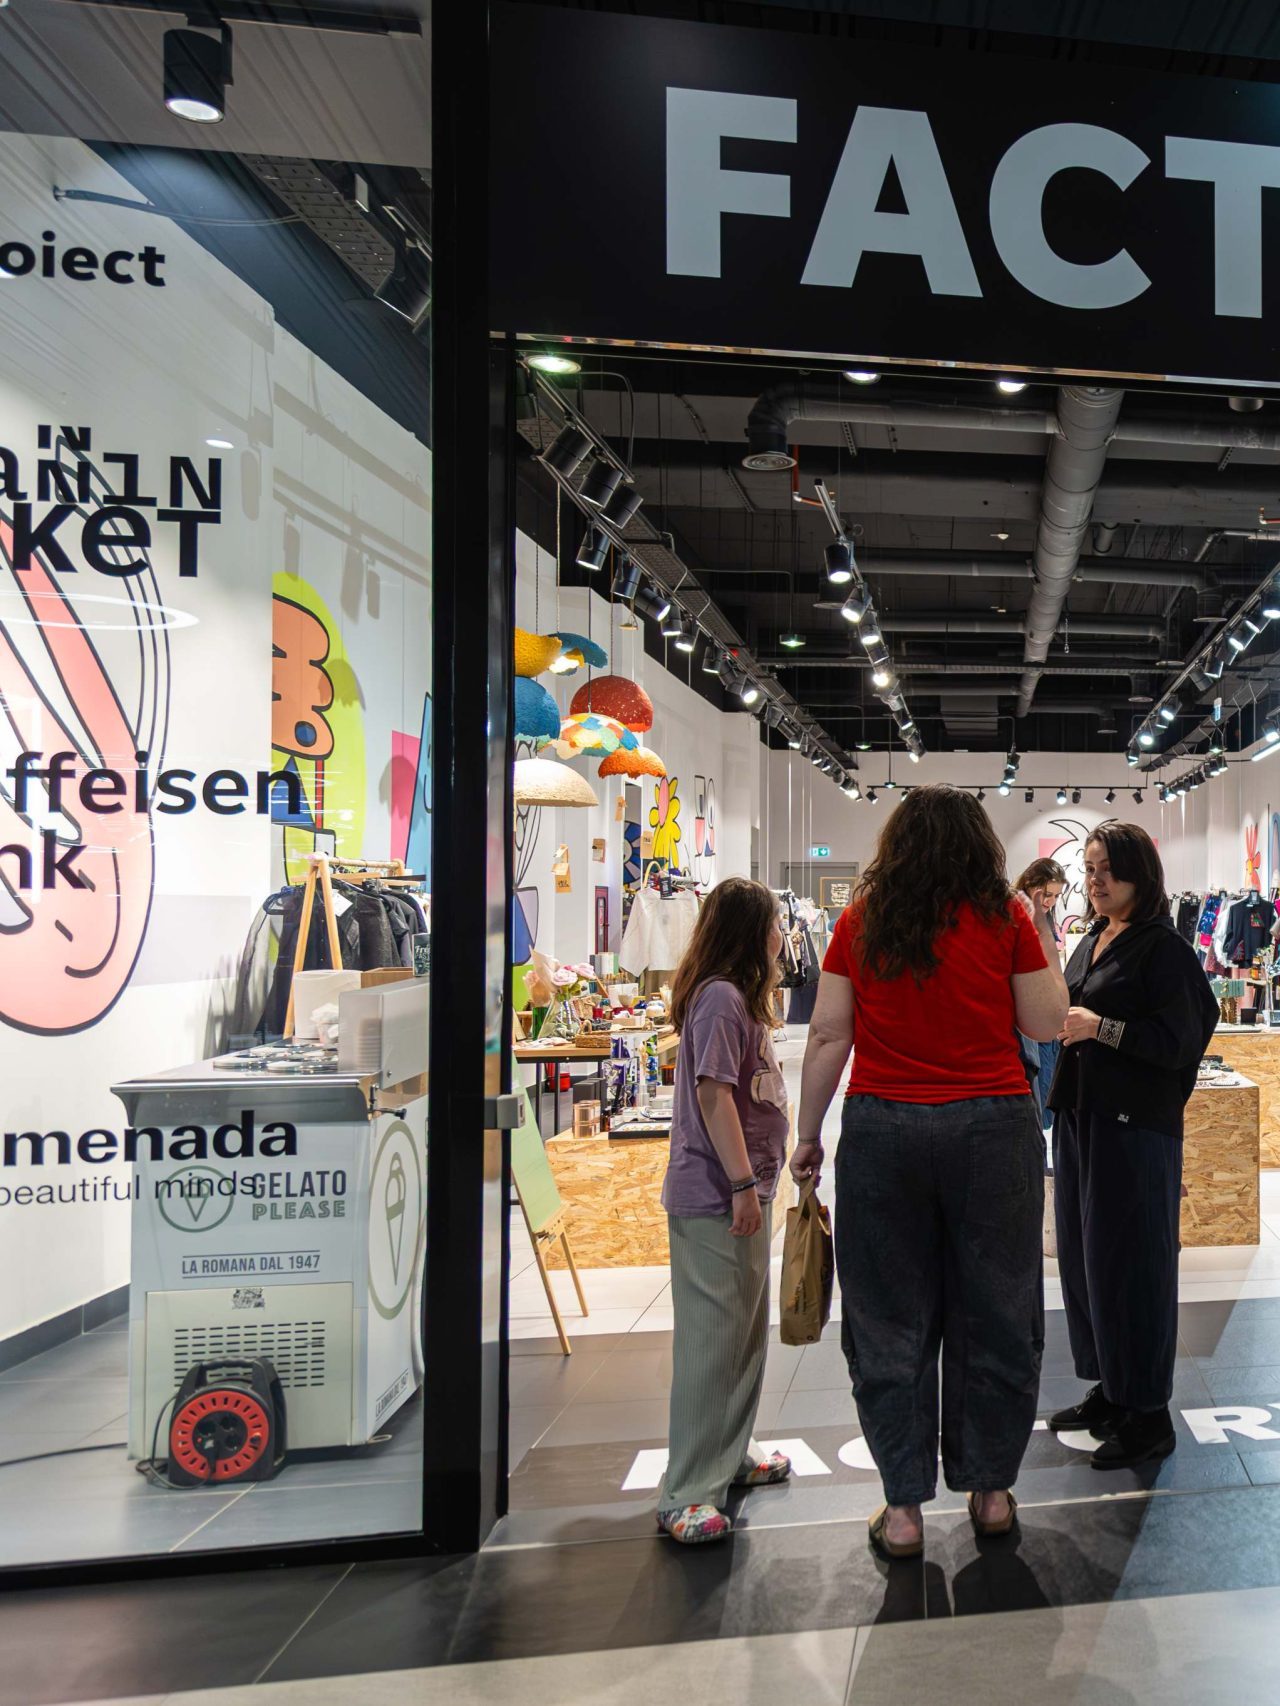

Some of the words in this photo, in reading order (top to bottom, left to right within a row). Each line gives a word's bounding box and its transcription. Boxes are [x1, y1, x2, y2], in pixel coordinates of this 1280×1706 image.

[5, 750, 301, 816] ffeisen
[3, 1110, 298, 1168] menada
[154, 1171, 257, 1201] minds
[252, 1169, 348, 1200] GELATO
[251, 1199, 346, 1222] PLEASE
[181, 1260, 198, 1275] LA
[201, 1257, 256, 1274] ROMANA
[259, 1256, 284, 1271] DAL
[289, 1254, 320, 1270] 1947
